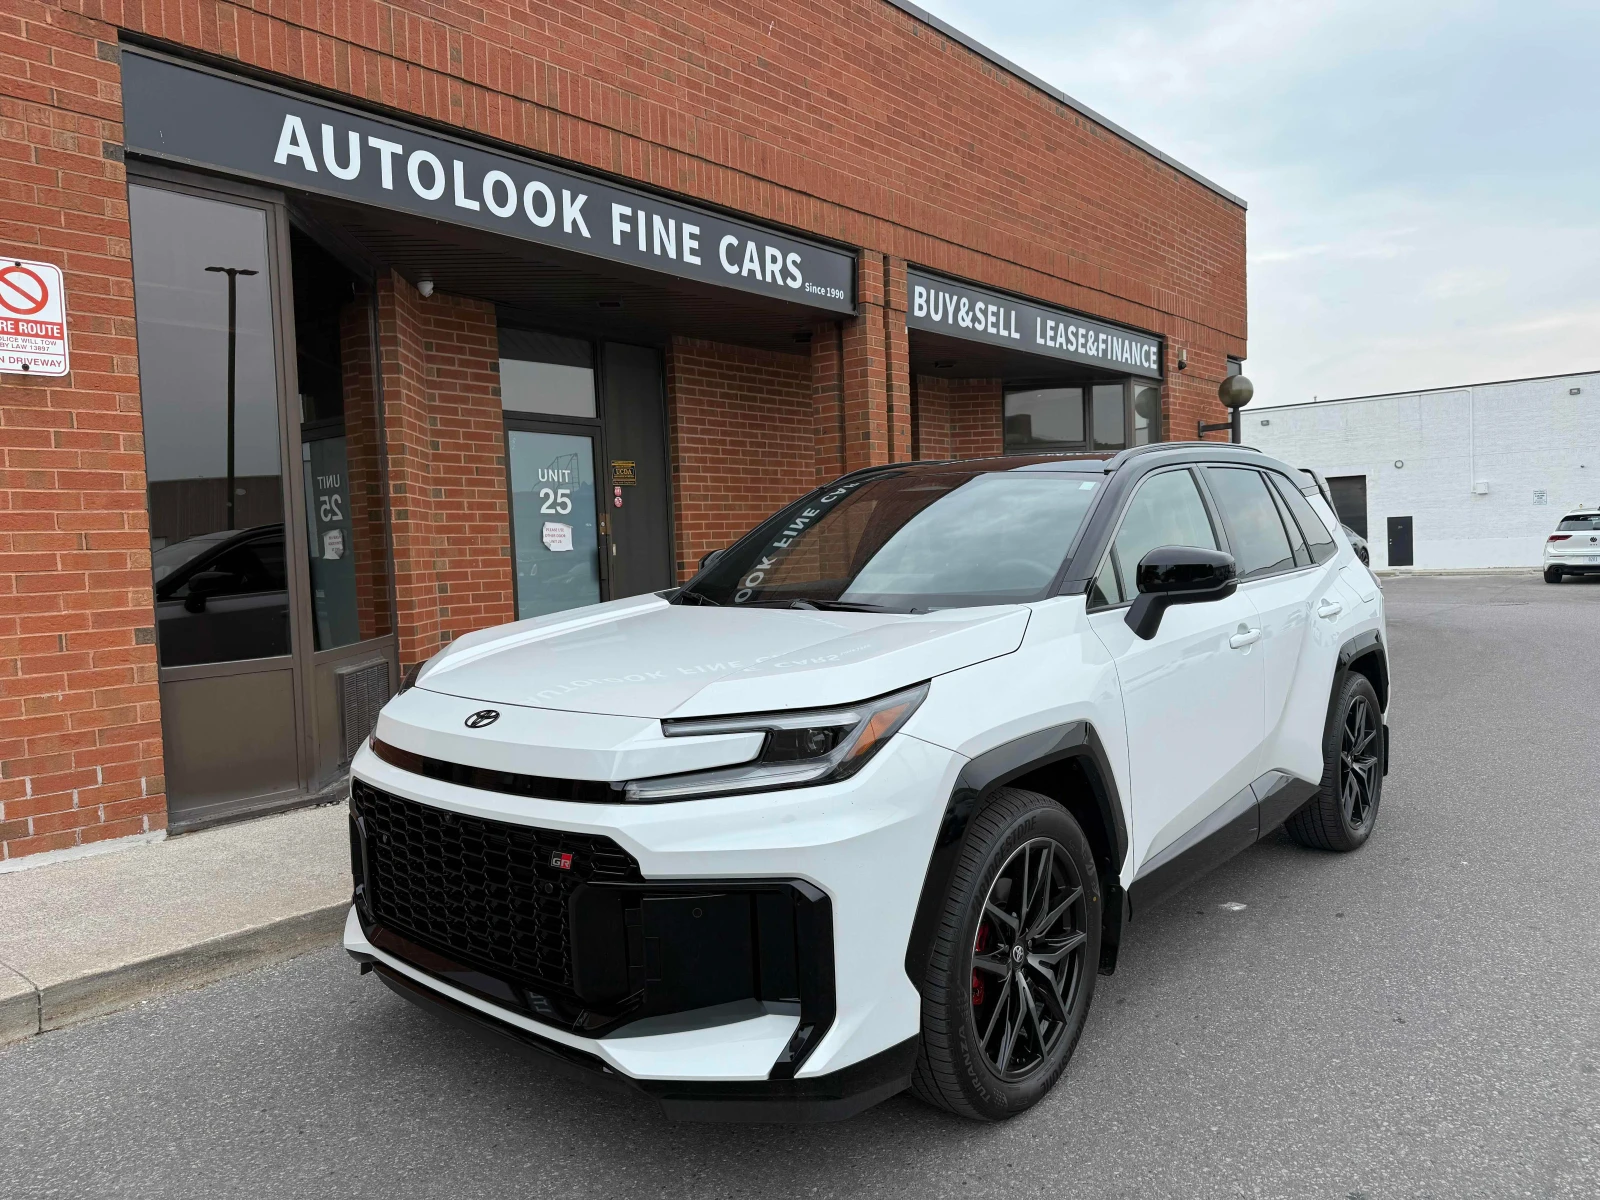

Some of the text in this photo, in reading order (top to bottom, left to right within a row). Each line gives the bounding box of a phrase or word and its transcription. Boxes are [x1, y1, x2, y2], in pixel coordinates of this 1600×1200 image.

[274, 114, 803, 289] AUTOLOOK FINE CARS
[805, 282, 845, 300] Since 1990
[18, 321, 61, 337] ROUTE
[913, 285, 1158, 370] BUY&SELL LEASE&FINANCE
[20, 337, 39, 345] WILL
[8, 356, 62, 368] DRIVEWAY
[538, 468, 571, 483] UNIT
[539, 487, 572, 515] 25
[552, 857, 570, 868] GR
[958, 1024, 991, 1104] TURANZA
